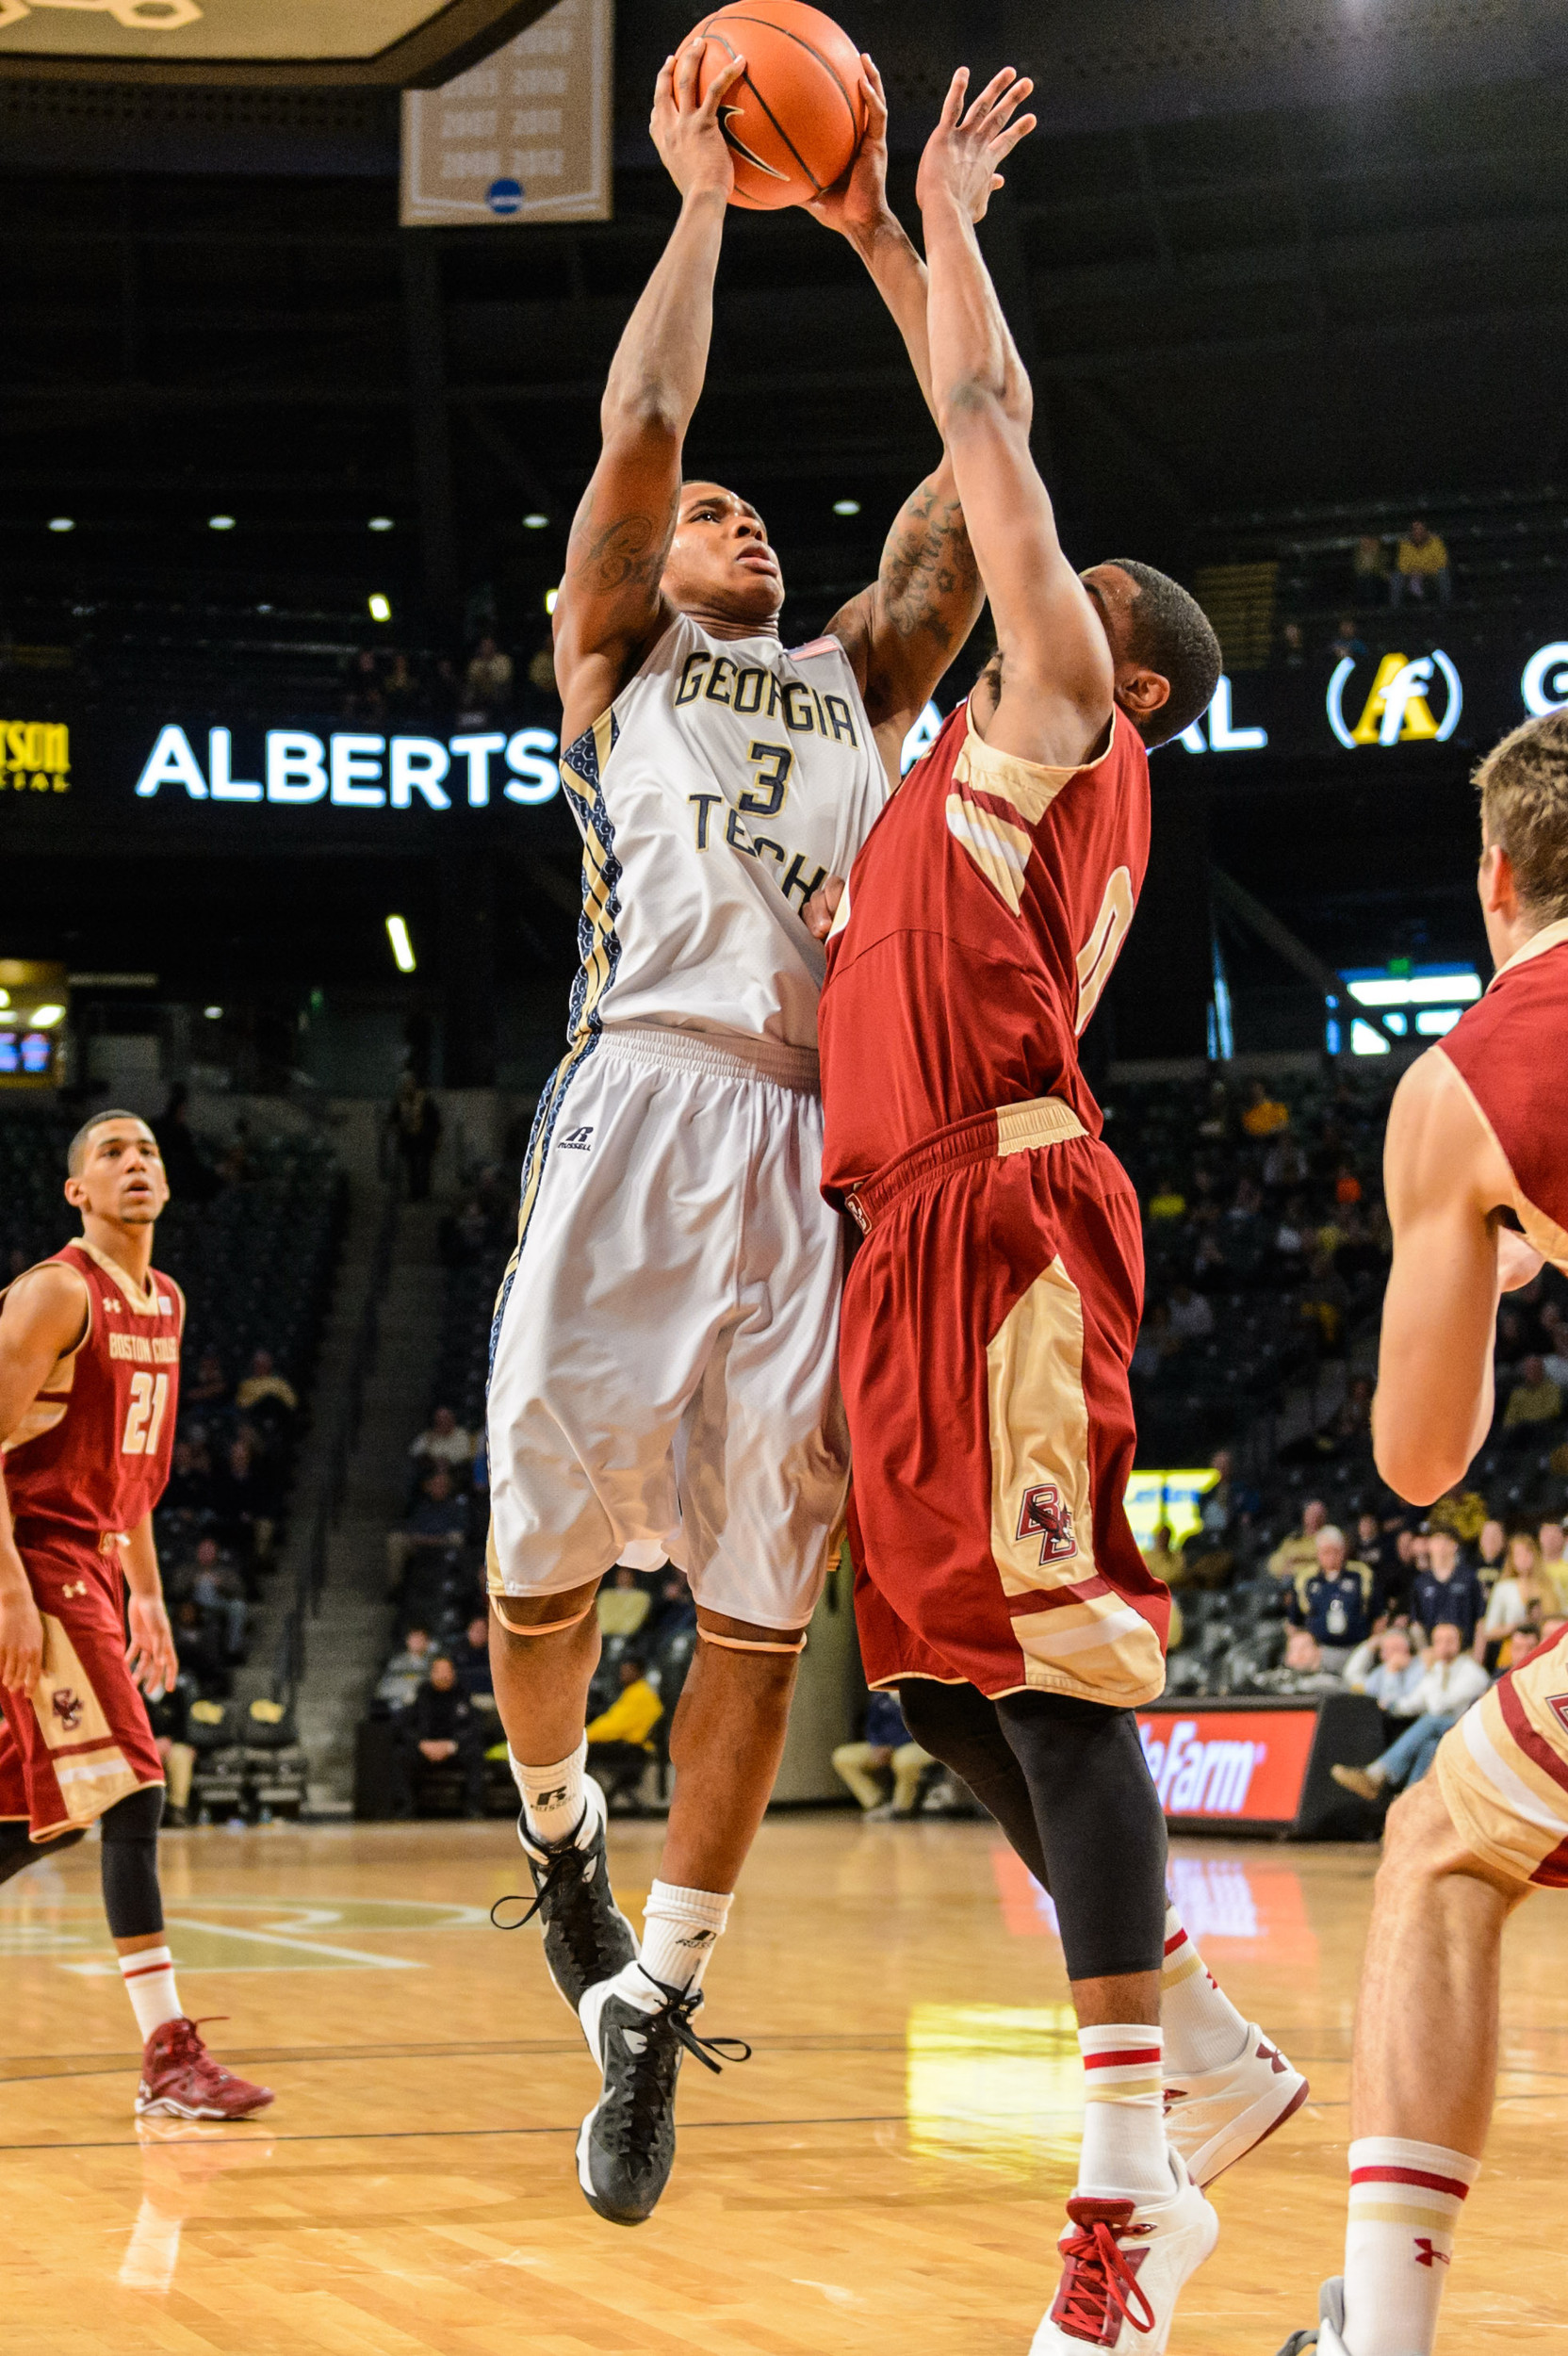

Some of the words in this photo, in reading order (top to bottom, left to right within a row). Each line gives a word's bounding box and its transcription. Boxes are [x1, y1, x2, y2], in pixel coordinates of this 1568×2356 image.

[674, 651, 860, 751] GEORGIA
[737, 740, 794, 819] 3
[1074, 865, 1134, 1036] 0
[558, 1141, 592, 1152] RUSSELL
[108, 1332, 152, 1364] BOSTON
[122, 1371, 169, 1455] 21
